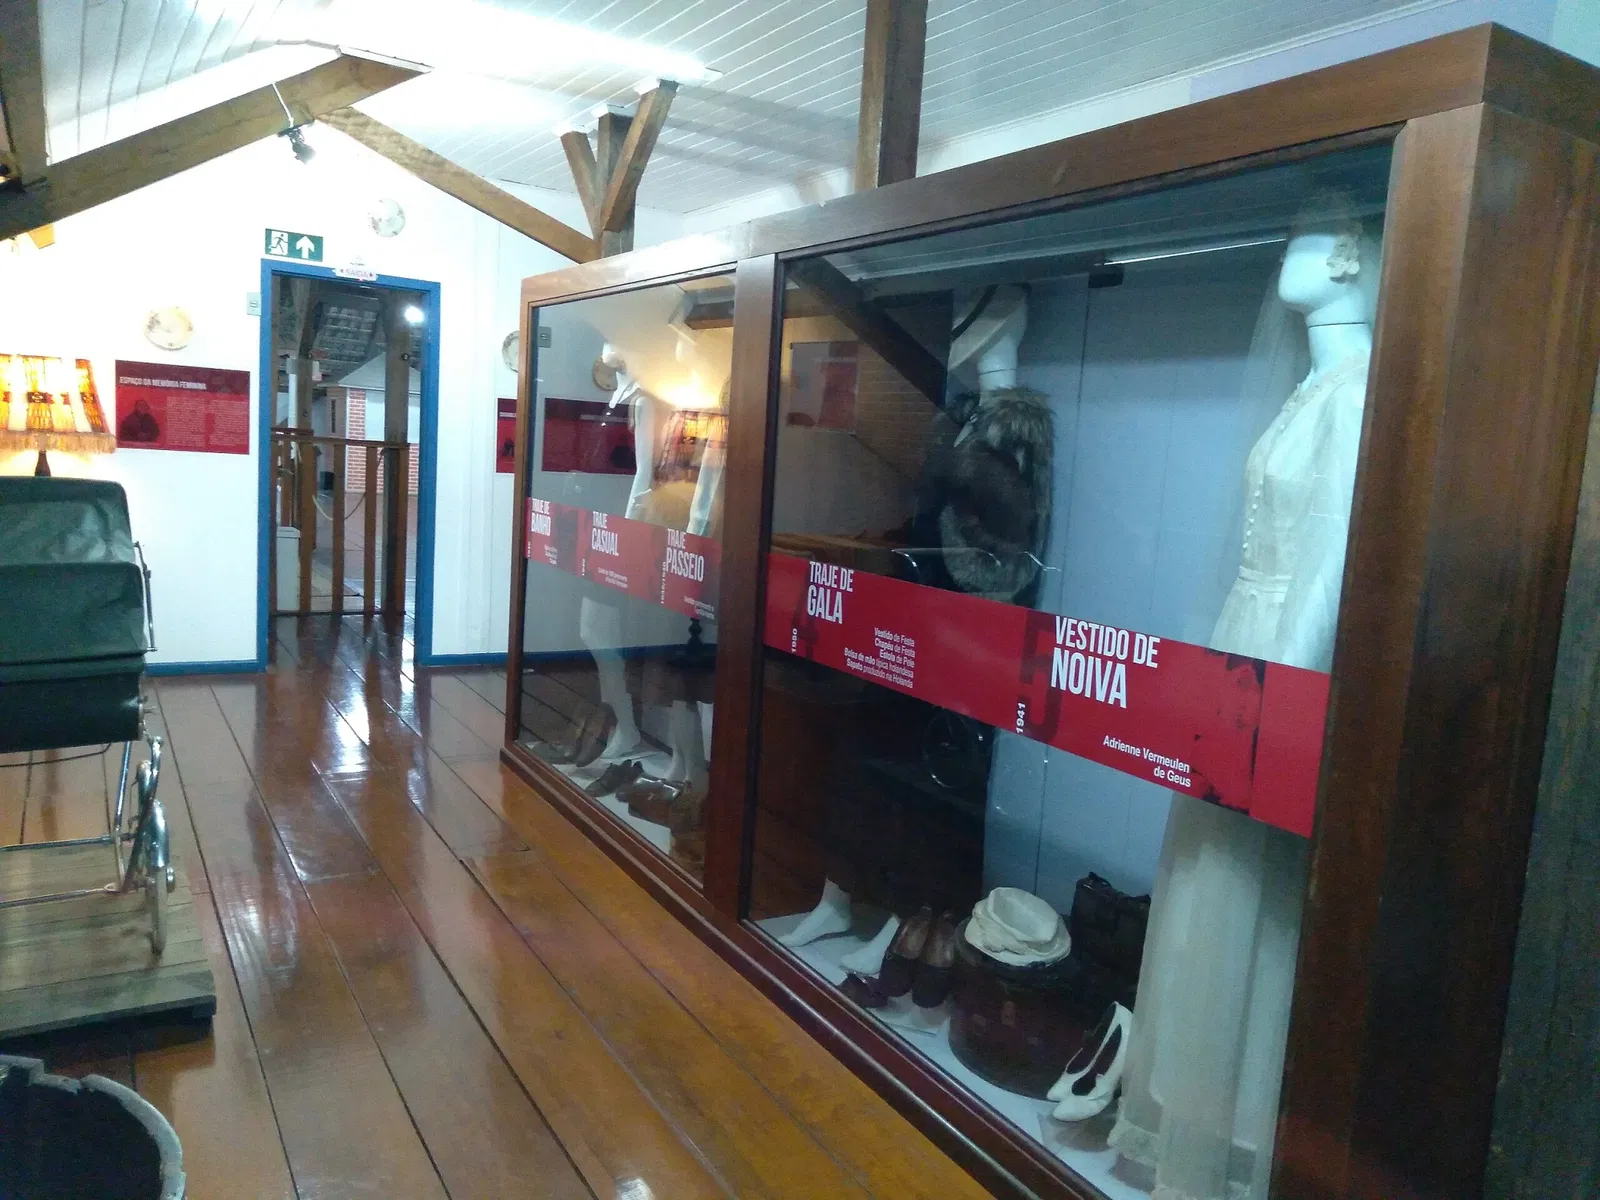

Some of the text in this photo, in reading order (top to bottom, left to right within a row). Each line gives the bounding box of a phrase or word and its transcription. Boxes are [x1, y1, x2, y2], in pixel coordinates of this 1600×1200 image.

[120, 376, 142, 386] ESPAÇO
[152, 379, 179, 388] MEMÓRIA
[531, 512, 551, 537] BANHO
[592, 511, 608, 529] TRAJE
[591, 528, 619, 556] CASUAL
[667, 528, 687, 549] TRAJE
[666, 547, 705, 582] PASSEIO
[809, 561, 854, 592] TRAJE DE
[807, 585, 843, 624] GALA
[874, 627, 915, 647] Vestido de Festa
[875, 637, 916, 658] Chapéu de Festa
[1055, 615, 1160, 668] VESTIDO DE
[844, 647, 858, 659] Bolsa
[858, 653, 864, 661] de
[865, 656, 876, 665] mão
[889, 662, 914, 678] holandesa
[880, 649, 896, 661] Estola
[896, 655, 902, 664] de
[846, 658, 913, 689] Sapato produzido na Holanda
[1050, 647, 1127, 708] NOIVA
[1016, 703, 1025, 734] 1941
[1103, 735, 1190, 773] Adrienne Vermeulen
[1154, 766, 1191, 787] de Geus
